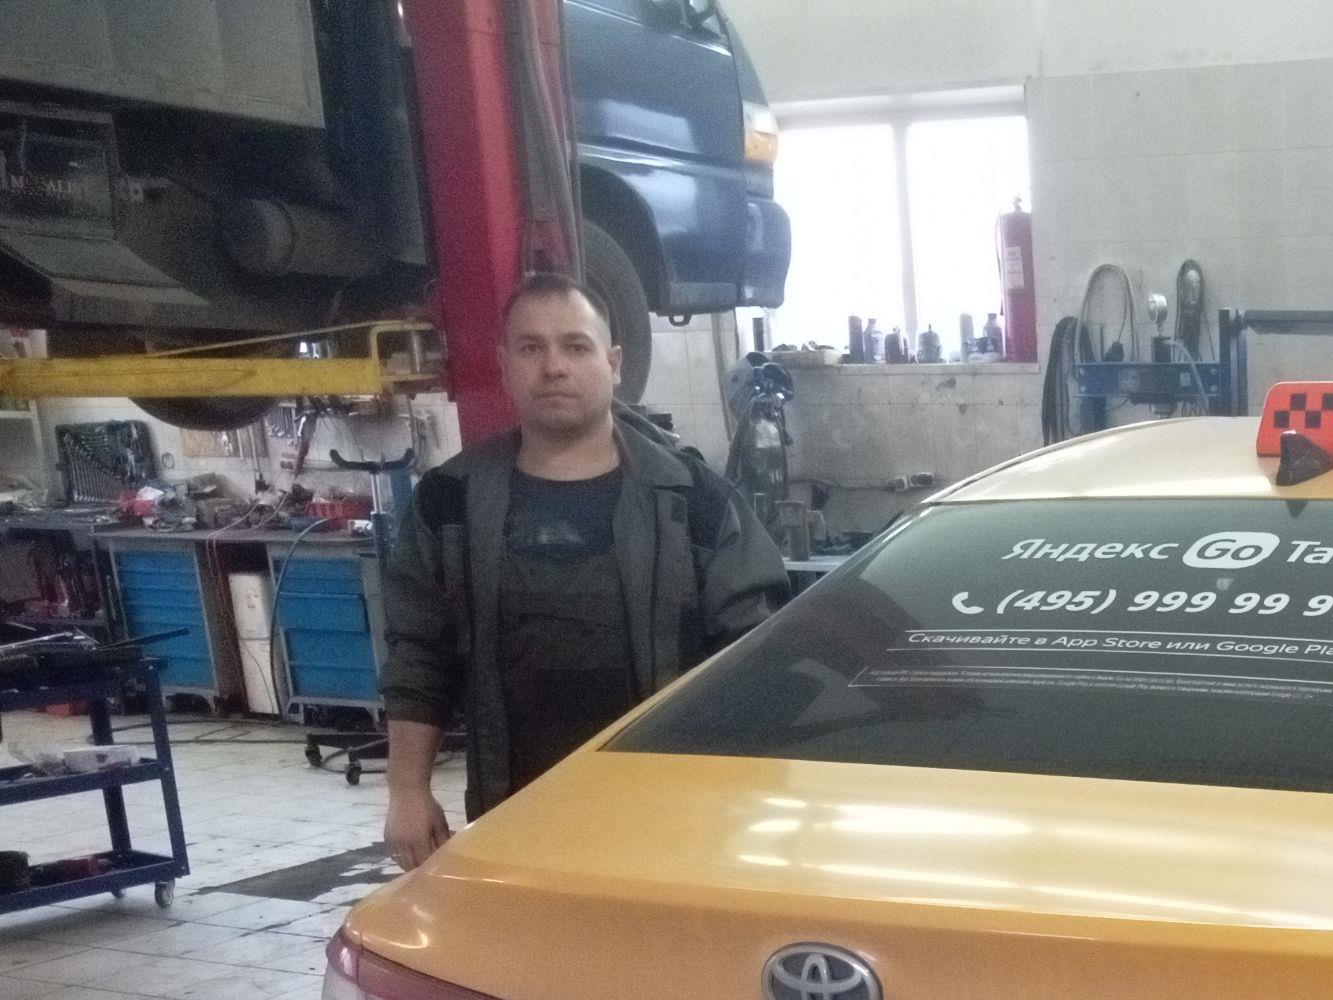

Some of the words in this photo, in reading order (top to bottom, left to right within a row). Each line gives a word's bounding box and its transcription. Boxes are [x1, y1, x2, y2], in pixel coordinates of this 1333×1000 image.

[1000, 538, 1180, 562] Яндекс
[996, 588, 1117, 614] (495)
[1126, 590, 1217, 613] 999
[1227, 592, 1290, 615] 99
[908, 633, 1031, 645] Скачивайте
[1034, 637, 1047, 645] в
[1051, 636, 1098, 648] App
[1102, 637, 1162, 650] Store
[1166, 641, 1211, 651] или
[1216, 641, 1300, 655] Google
